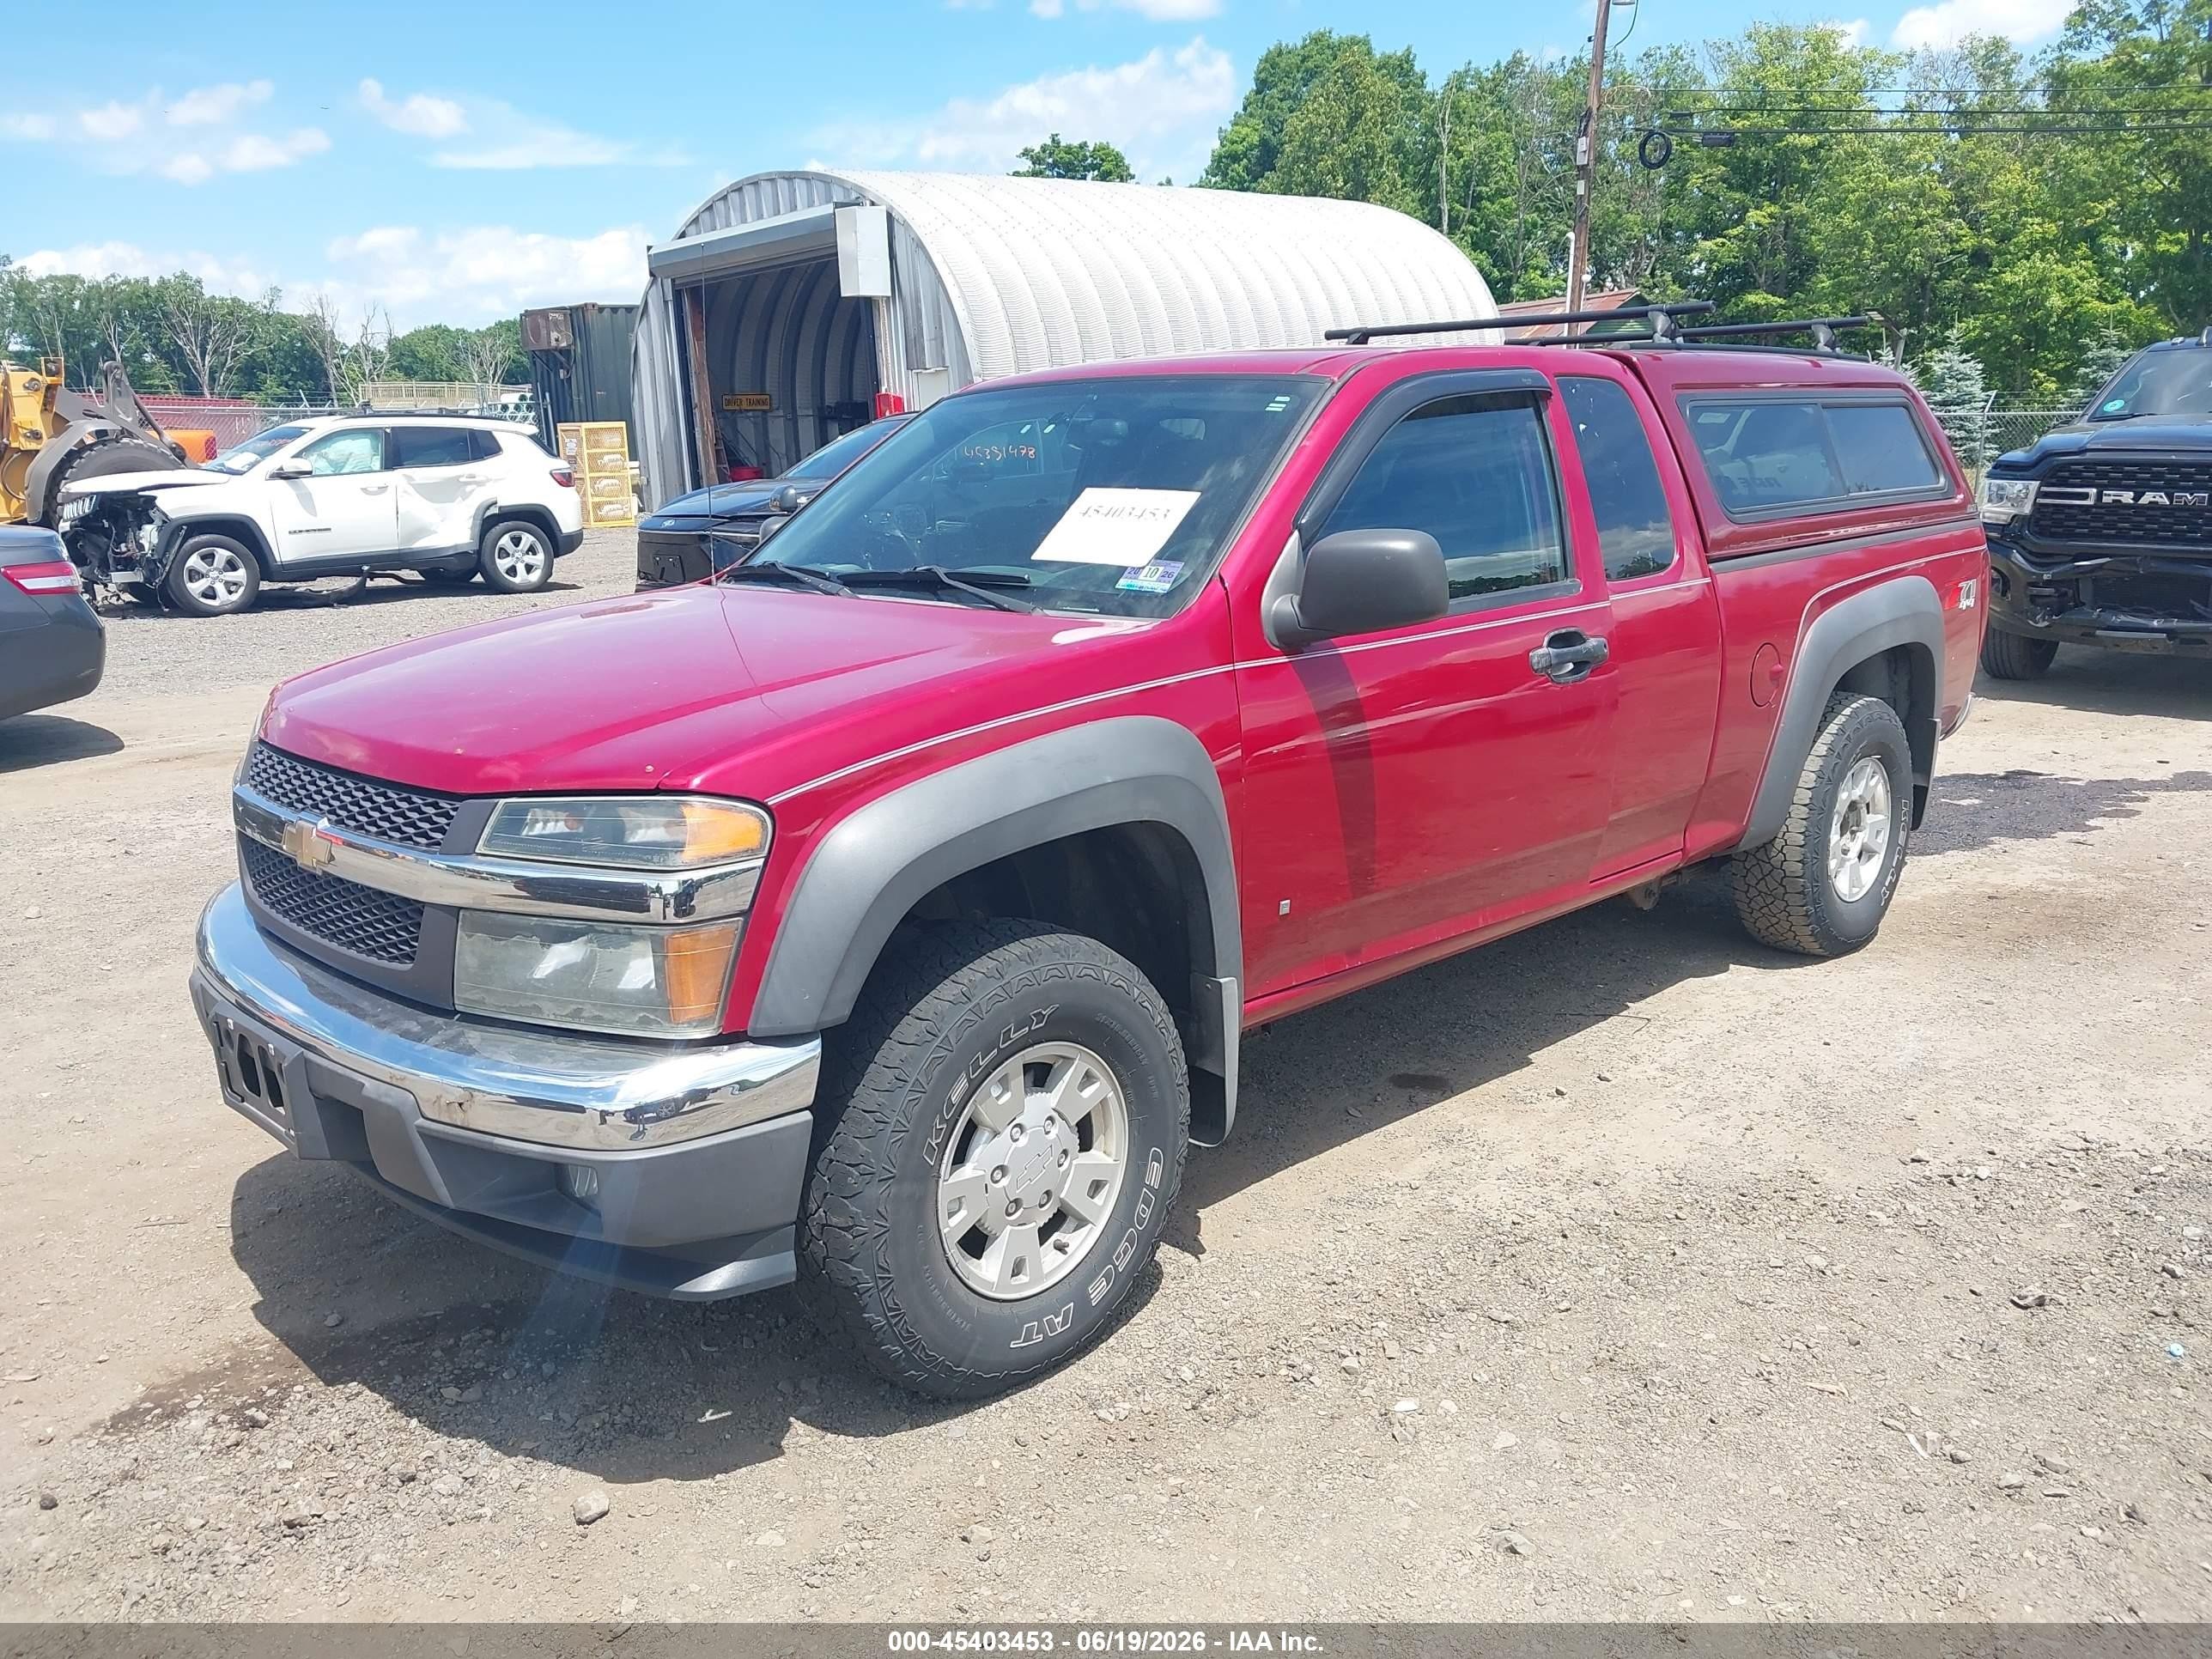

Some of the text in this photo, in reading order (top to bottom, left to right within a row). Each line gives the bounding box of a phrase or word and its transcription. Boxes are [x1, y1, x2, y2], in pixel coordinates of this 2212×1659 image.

[724, 398, 769, 407] DRIVER TRAINING
[2101, 490, 2209, 506] RAM
[1143, 567, 1160, 579] 10
[1160, 570, 1176, 579] 26
[1881, 799, 1910, 906] KELLY
[923, 1004, 1060, 1166] KELLY
[1088, 1147, 1164, 1306] EDGE
[1010, 1302, 1074, 1348] AT
